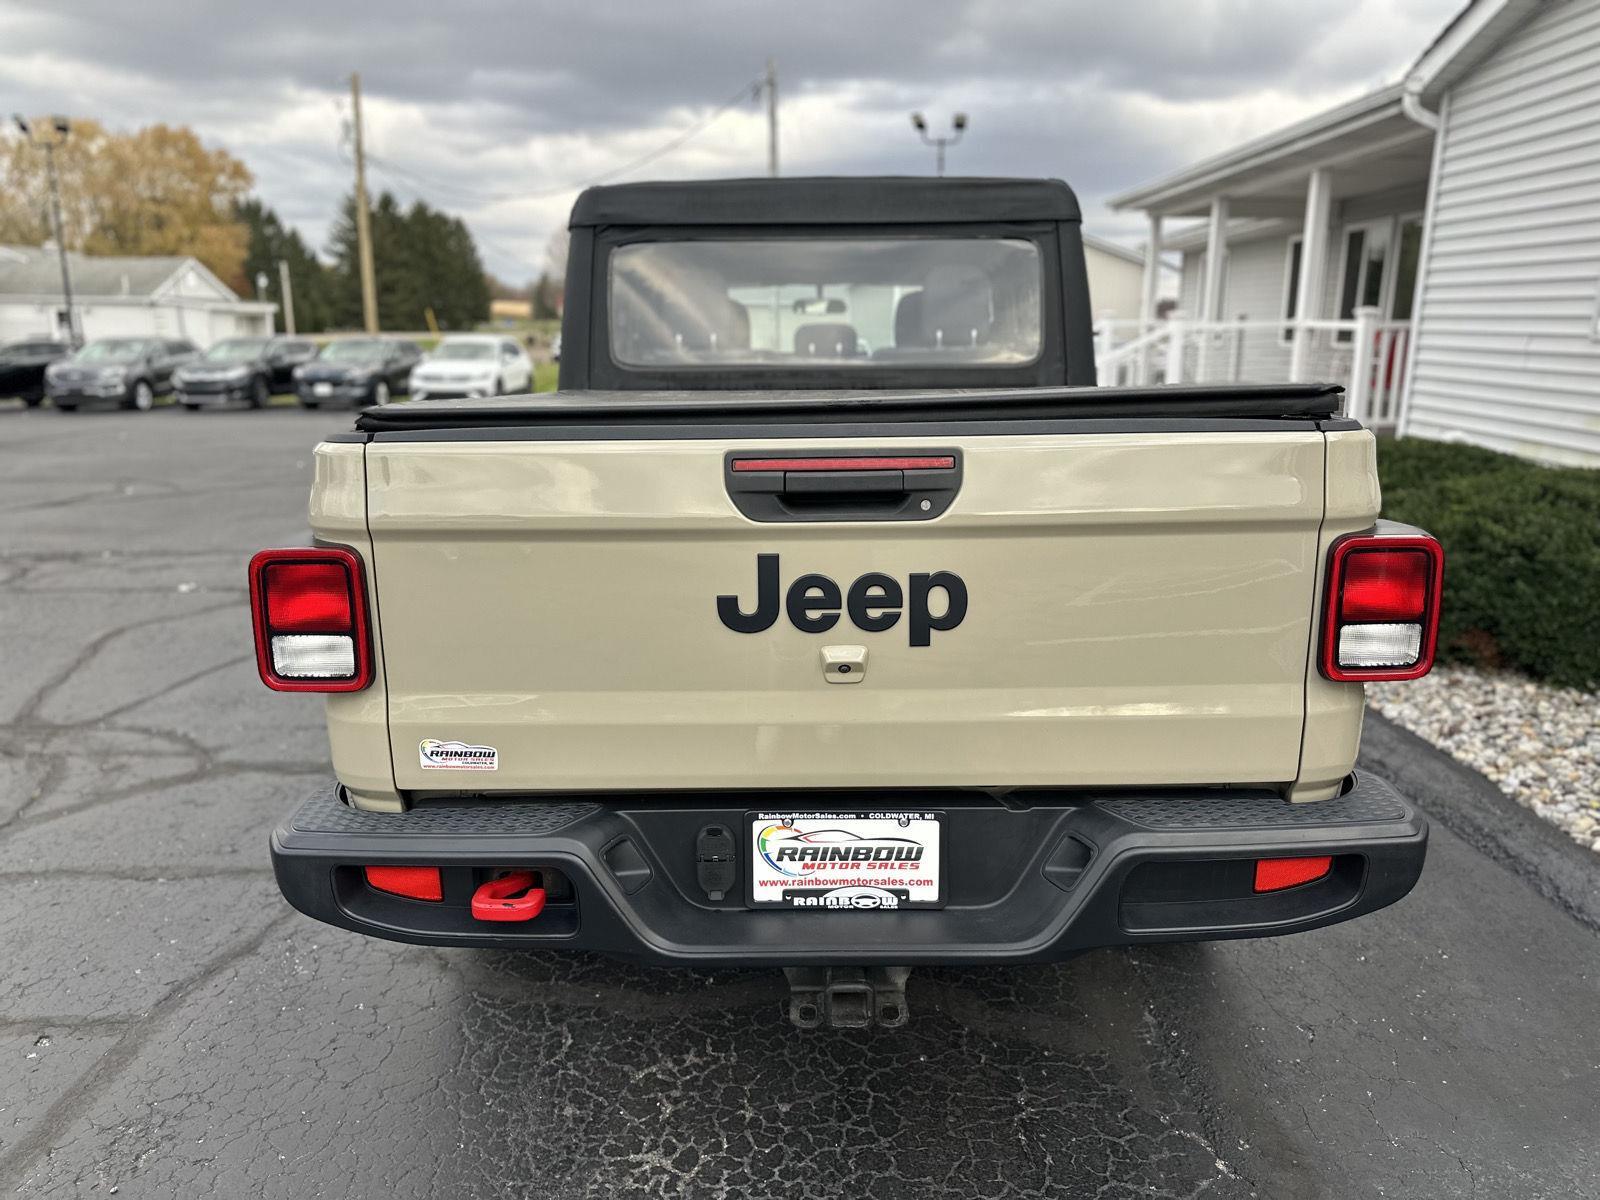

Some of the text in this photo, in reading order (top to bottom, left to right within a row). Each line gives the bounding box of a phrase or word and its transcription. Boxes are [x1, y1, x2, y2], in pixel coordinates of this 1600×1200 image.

[716, 553, 968, 647] Jeep
[758, 812, 856, 820] RainbowMotorSales.com
[869, 812, 922, 820] COLDWATER,
[776, 846, 924, 862] RAINBOW
[801, 862, 920, 870] MOTOR SALES
[758, 876, 934, 887] www.rainbowmotorsales.com
